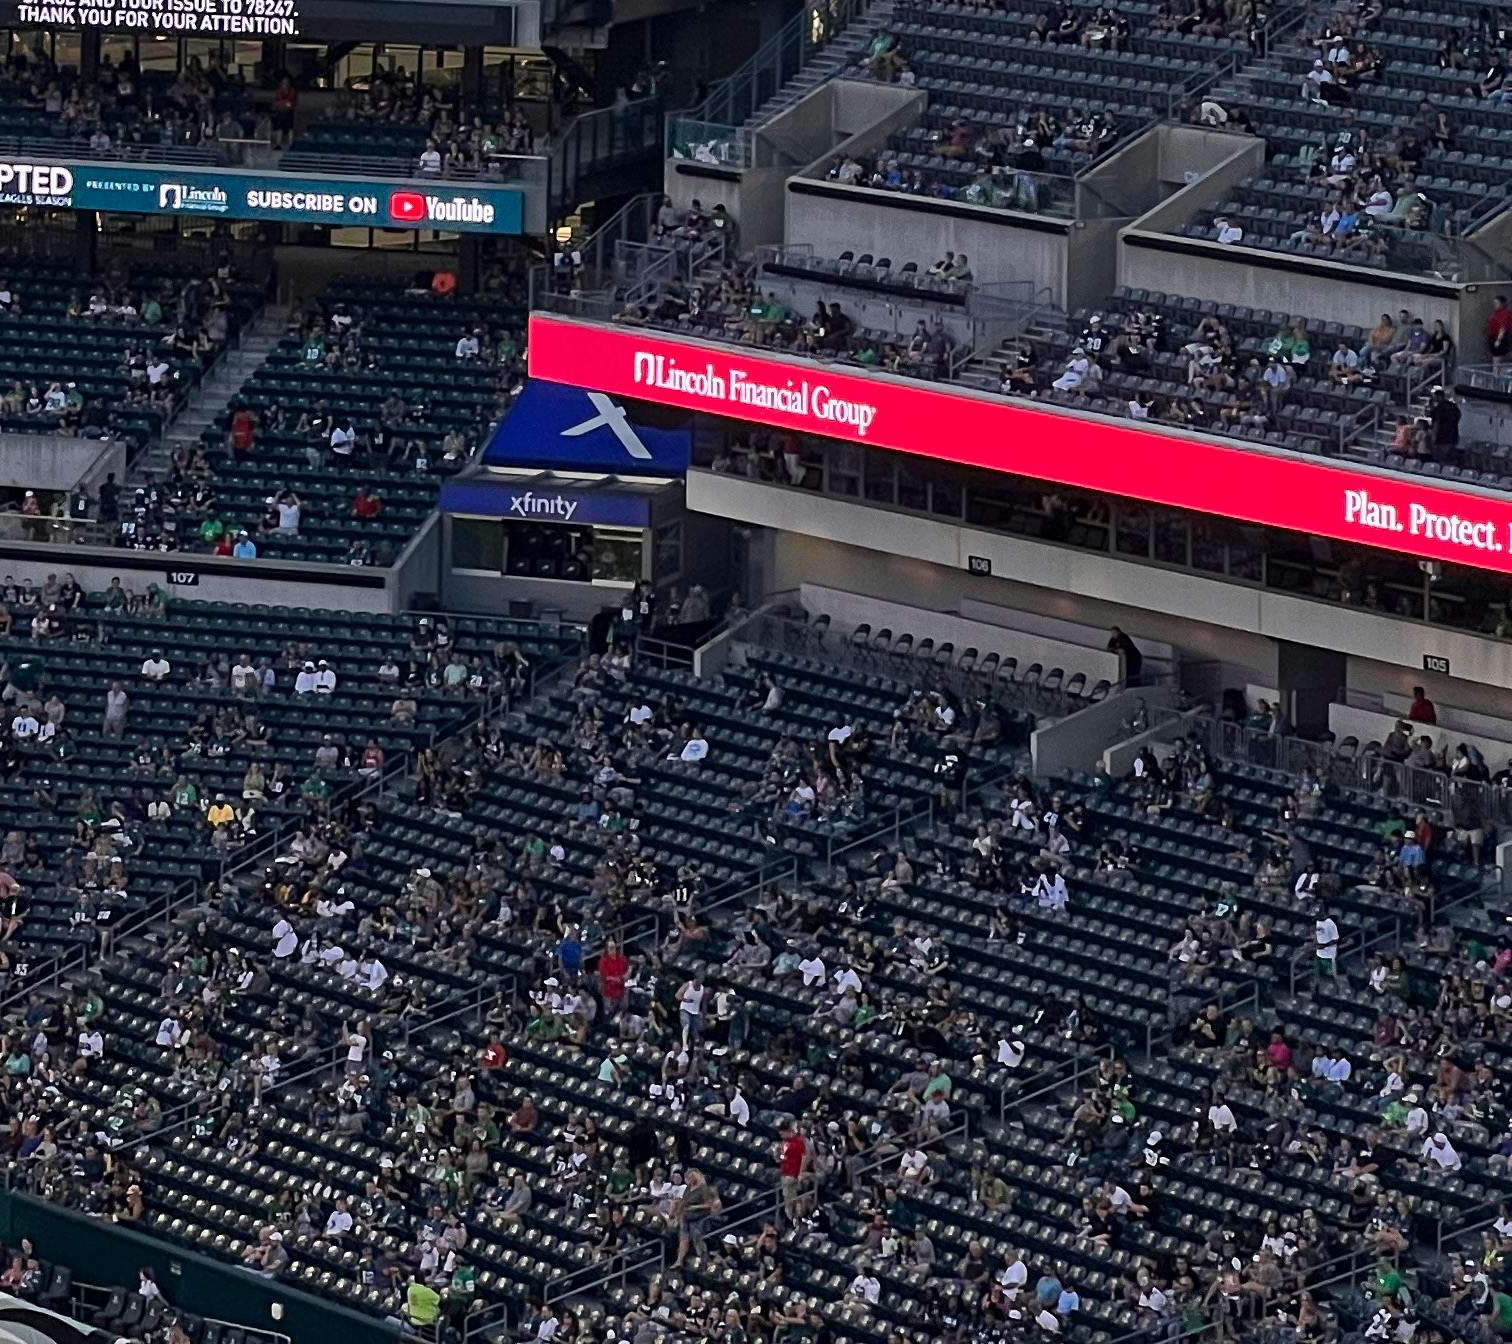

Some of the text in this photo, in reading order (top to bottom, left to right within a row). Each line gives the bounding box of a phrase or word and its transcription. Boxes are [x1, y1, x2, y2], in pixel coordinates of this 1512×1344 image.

[17, 4, 301, 36] THANK YOU FOR YOUR ATTENTION.
[181, 185, 228, 204] Lincoln
[246, 190, 495, 223] SUBSCRIBE ON YouTube
[654, 355, 872, 437] Lincoln Financial Group
[510, 491, 578, 520] xfinity
[1344, 489, 1404, 533] Plan.
[1409, 502, 1503, 551] Protect.
[170, 571, 196, 585] 107
[970, 557, 990, 572] 106
[1425, 656, 1447, 672] 105
